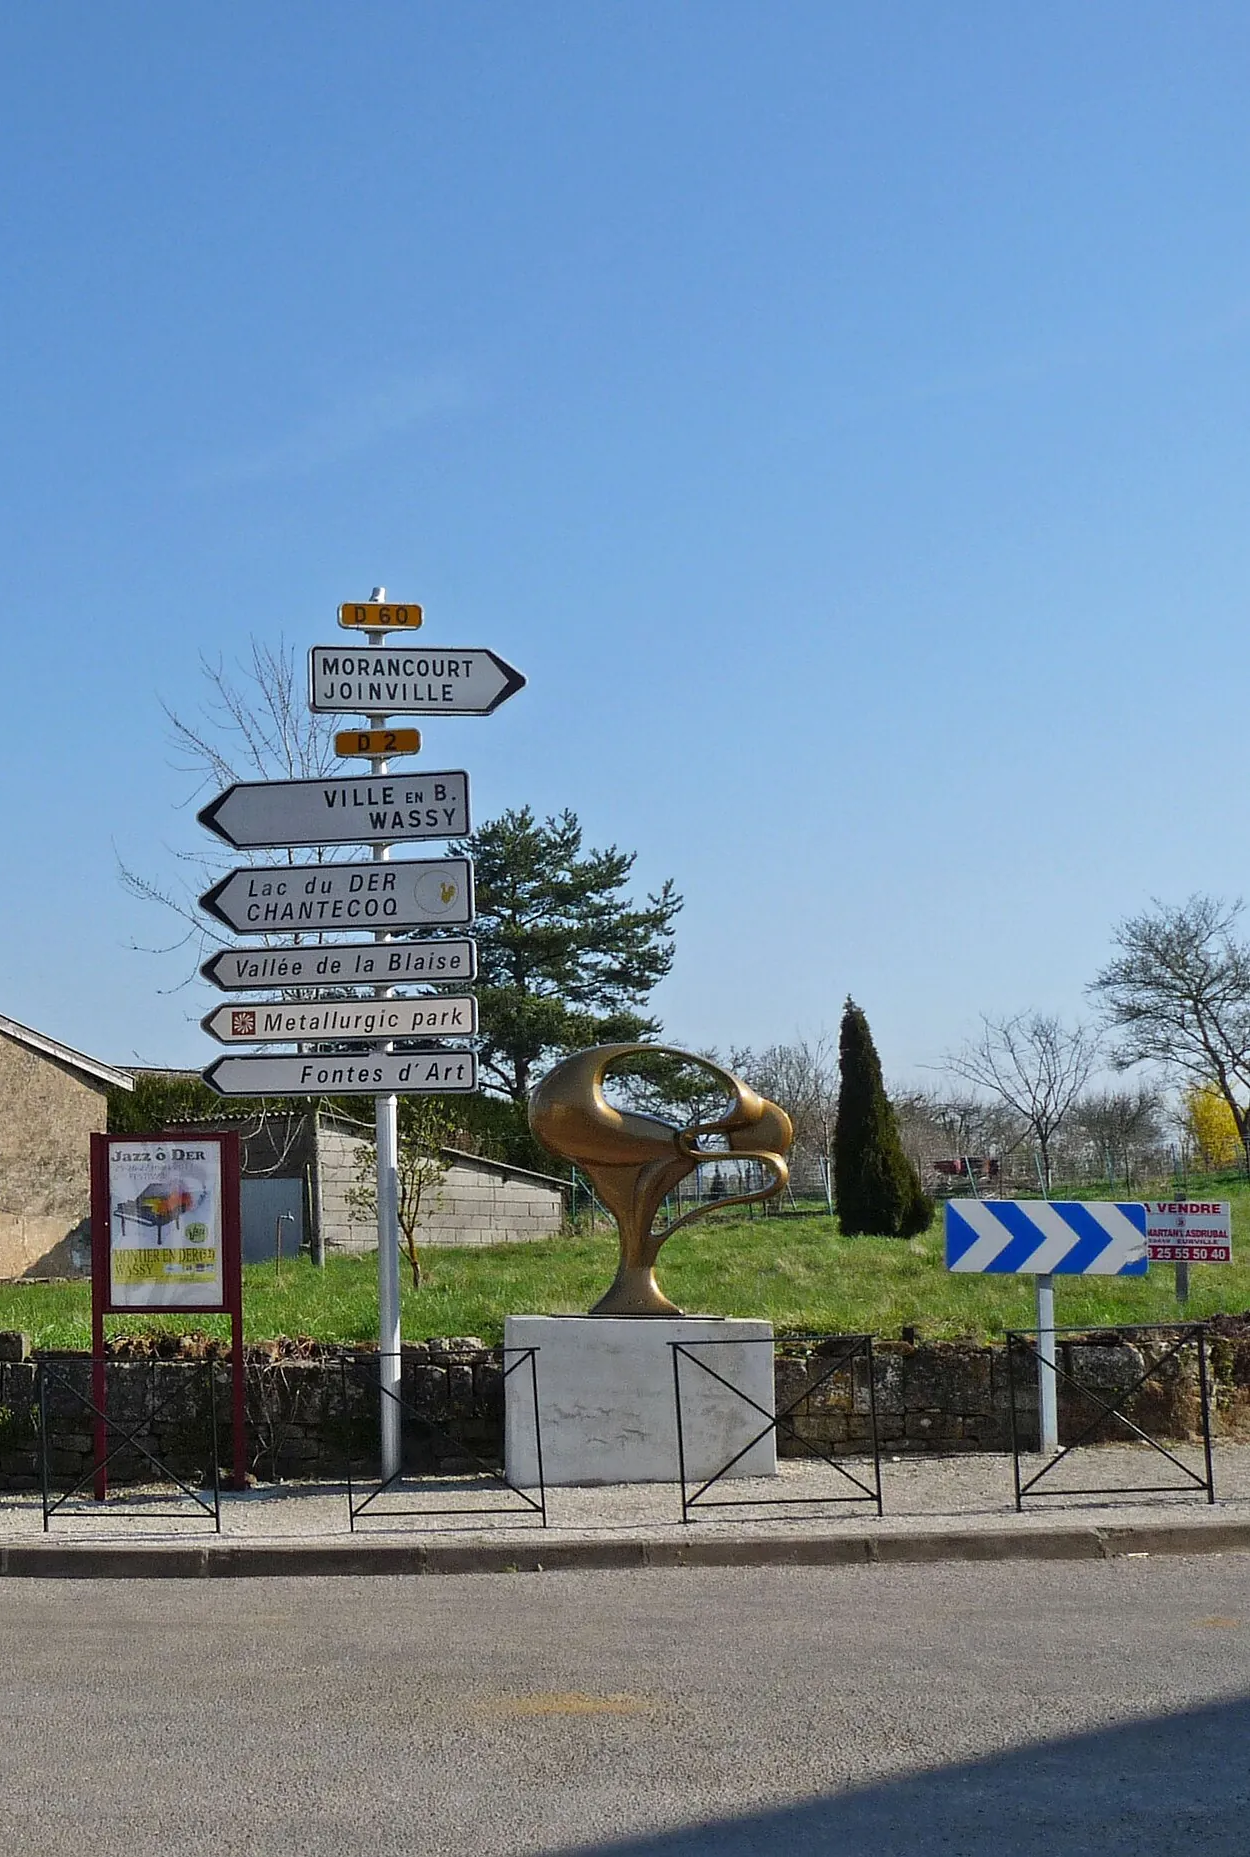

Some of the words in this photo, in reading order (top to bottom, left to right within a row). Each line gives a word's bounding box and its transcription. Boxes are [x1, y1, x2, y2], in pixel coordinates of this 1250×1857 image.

[354, 606, 366, 624] D
[379, 606, 409, 625] 60
[321, 657, 474, 679] MORANCOURT
[324, 682, 454, 702] JOINVILLE
[358, 734, 371, 752] D
[384, 733, 398, 751] 2
[323, 786, 395, 809] VILLE
[405, 791, 423, 804] EN
[434, 783, 457, 802] B.
[369, 807, 456, 830] WASSY
[248, 878, 287, 897] Lac
[305, 876, 332, 894] du
[349, 872, 396, 893] DER
[247, 897, 398, 922] CHANTECOQ
[235, 956, 302, 978] Vallée
[316, 955, 341, 975] de
[355, 954, 374, 973] la
[388, 952, 461, 971] Blaise
[264, 1009, 399, 1033] Metallurgic
[411, 1007, 463, 1030] park
[301, 1064, 383, 1084] Fontes
[111, 1150, 151, 1162] Jazz
[155, 1147, 167, 1161] ô
[1156, 1202, 1222, 1214] VENDRE
[1186, 1229, 1228, 1239] ASDRUBAL
[163, 1248, 176, 1261] EN
[1157, 1247, 1171, 1258] 25
[1175, 1248, 1190, 1259] 55
[1193, 1248, 1208, 1259] 50
[1211, 1249, 1226, 1260] 40
[115, 1263, 154, 1275] WASSY
